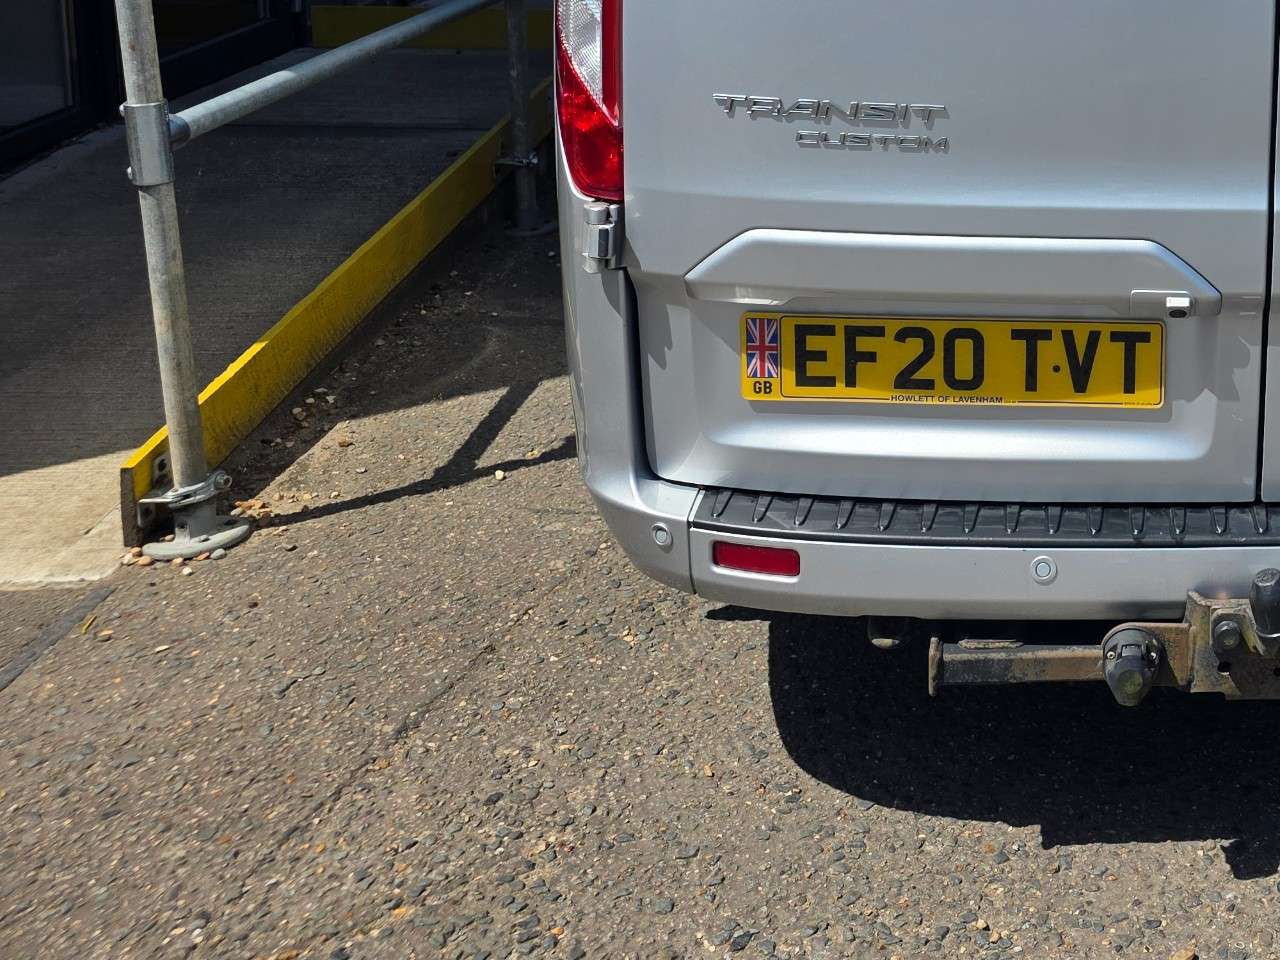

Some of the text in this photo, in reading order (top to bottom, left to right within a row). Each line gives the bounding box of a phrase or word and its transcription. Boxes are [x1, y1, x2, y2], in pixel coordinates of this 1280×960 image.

[712, 93, 947, 126] TRANSIT
[796, 130, 949, 151] CUSTOM
[793, 323, 1152, 395] EF20 TVT
[752, 380, 773, 396] GB
[890, 394, 935, 403] HOWLETT
[937, 395, 950, 403] OF
[953, 395, 1004, 404] LAVENHAM
